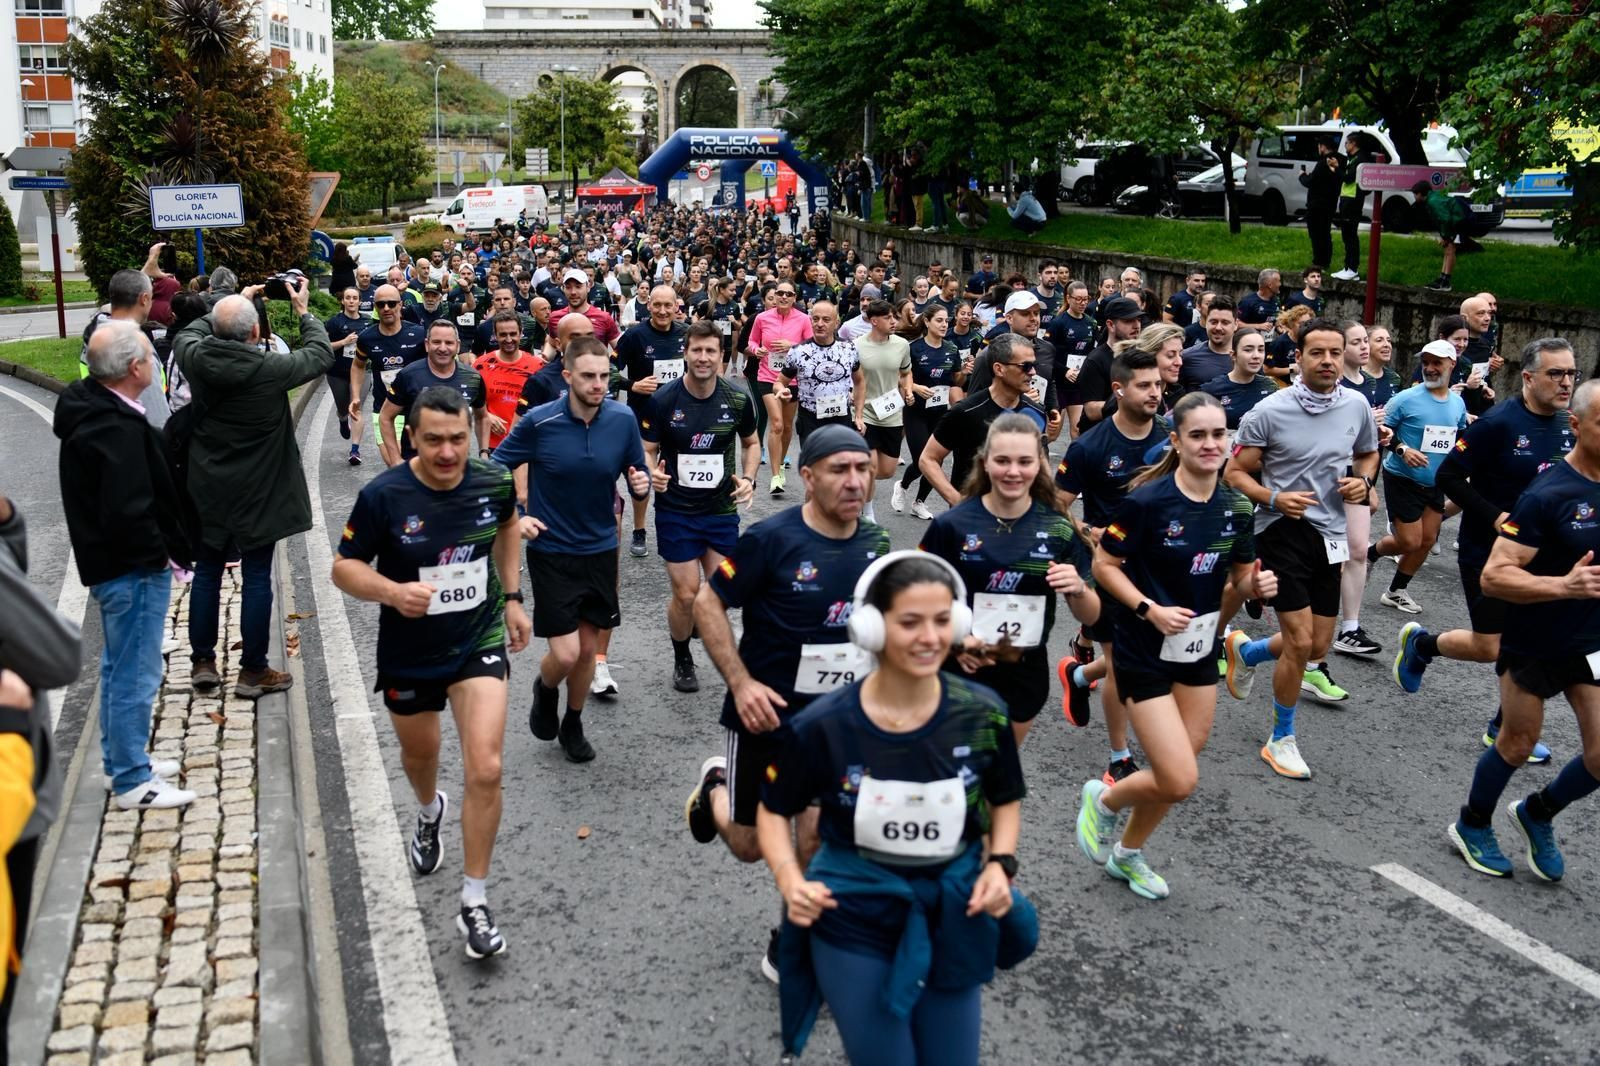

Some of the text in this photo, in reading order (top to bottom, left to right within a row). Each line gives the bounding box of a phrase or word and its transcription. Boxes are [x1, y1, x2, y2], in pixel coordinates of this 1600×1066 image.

[690, 135, 760, 145] POLICIA
[690, 145, 779, 155] NACIONAL
[1362, 177, 1395, 186] Santomé
[175, 192, 218, 201] GLORIETA
[191, 203, 204, 211] DA
[158, 211, 238, 222] POLICÍA NACIONAL
[661, 371, 678, 379] 719
[824, 406, 841, 414] 453
[884, 402, 896, 412] 59
[1431, 439, 1450, 449] 465
[689, 472, 714, 482] 720
[439, 585, 477, 603] 680
[997, 621, 1021, 637] 42
[1185, 639, 1203, 654] 40
[816, 670, 855, 686] 779
[883, 820, 940, 841] 696
